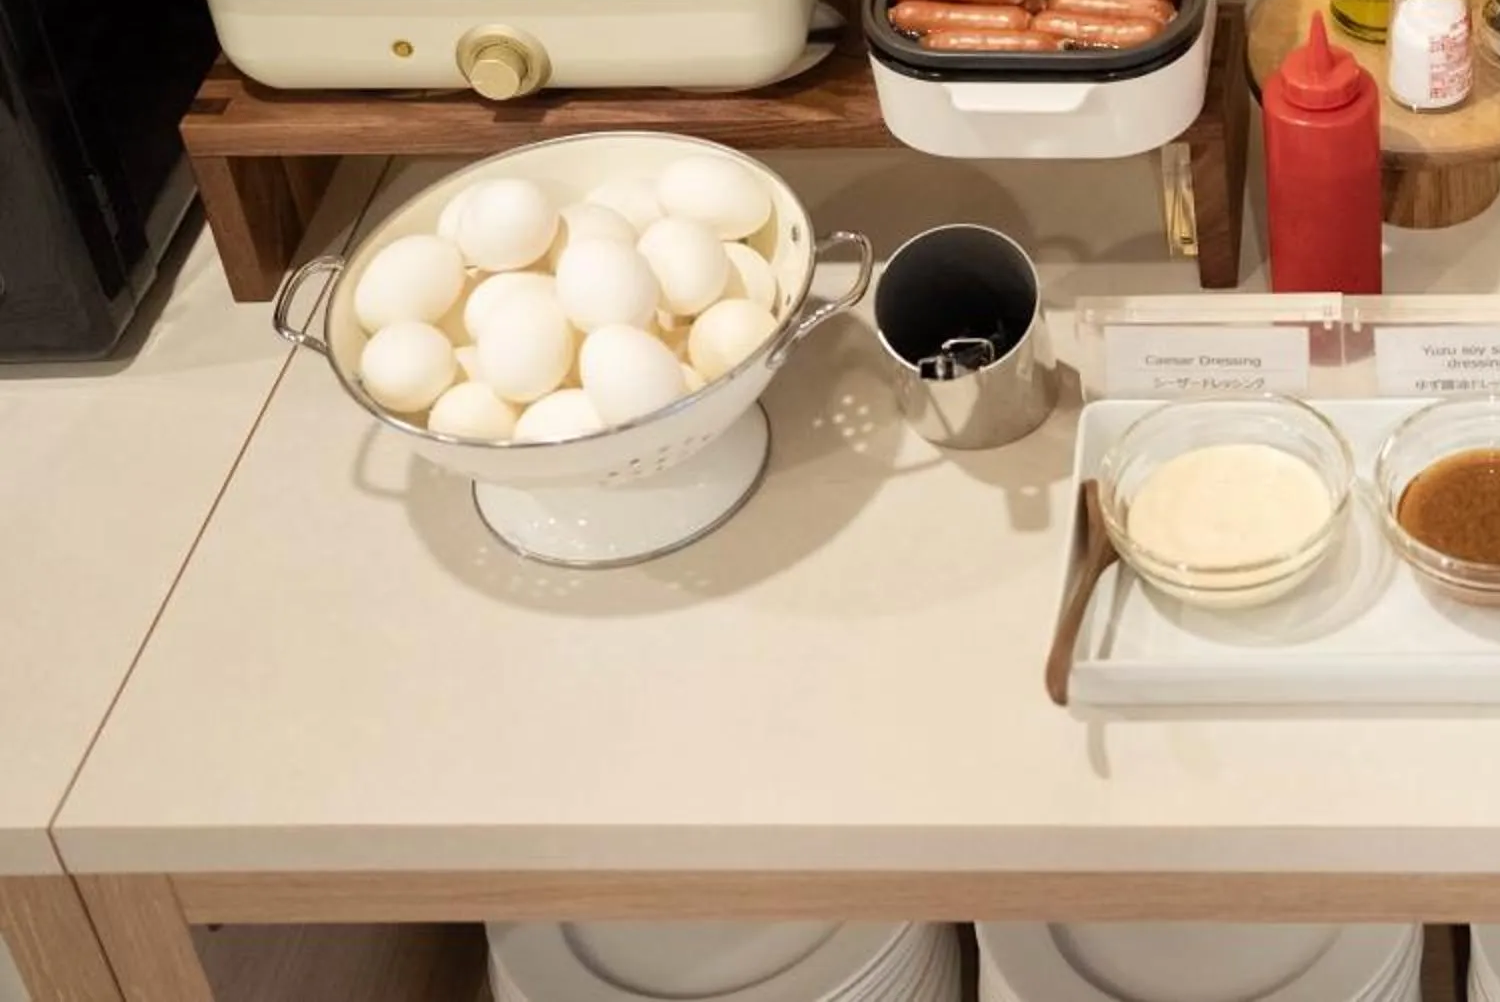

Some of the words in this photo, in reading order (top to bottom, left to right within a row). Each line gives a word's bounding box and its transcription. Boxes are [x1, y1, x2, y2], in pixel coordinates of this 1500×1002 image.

[1421, 344, 1458, 357] Yuzu
[1145, 354, 1195, 367] Caesar
[1198, 355, 1262, 368] Dressing
